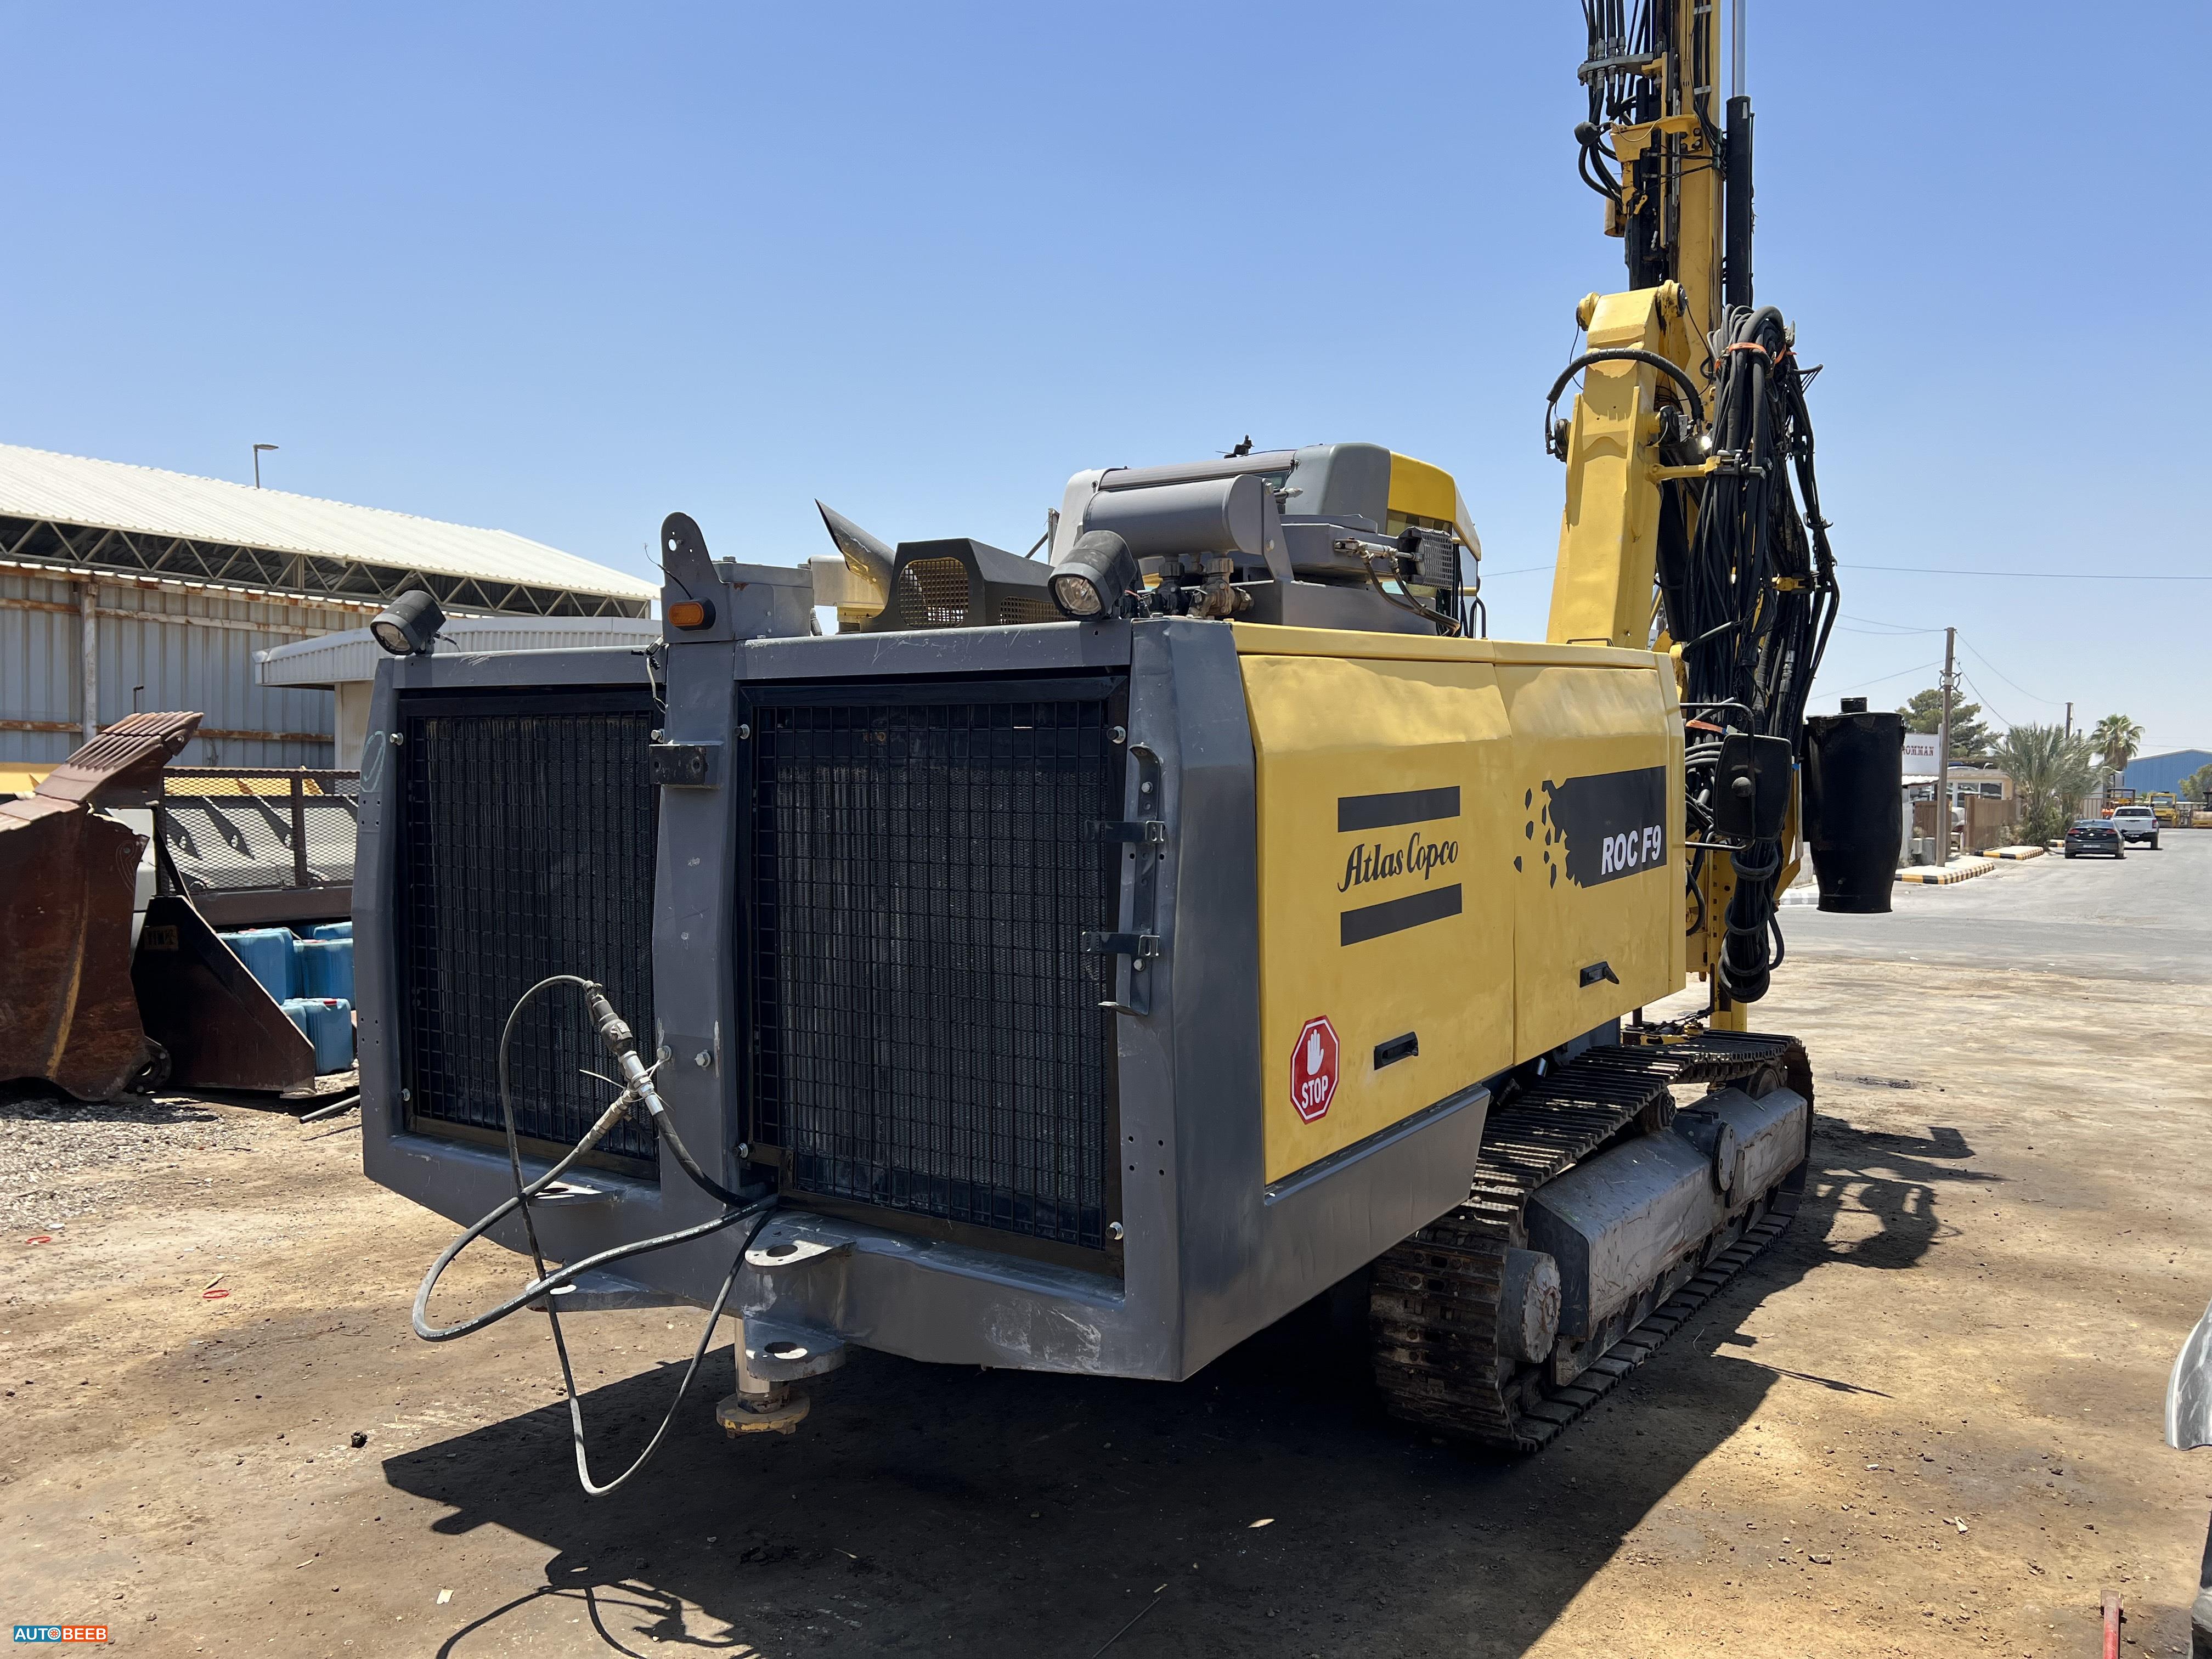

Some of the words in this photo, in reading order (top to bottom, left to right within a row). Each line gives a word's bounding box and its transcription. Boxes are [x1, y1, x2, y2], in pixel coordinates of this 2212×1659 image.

[1338, 843, 1403, 893] Atlas
[1407, 832, 1458, 881] Copco
[1601, 830, 1638, 875] ROC
[1641, 825, 1661, 863] F9
[1301, 1075, 1329, 1109] STOP
